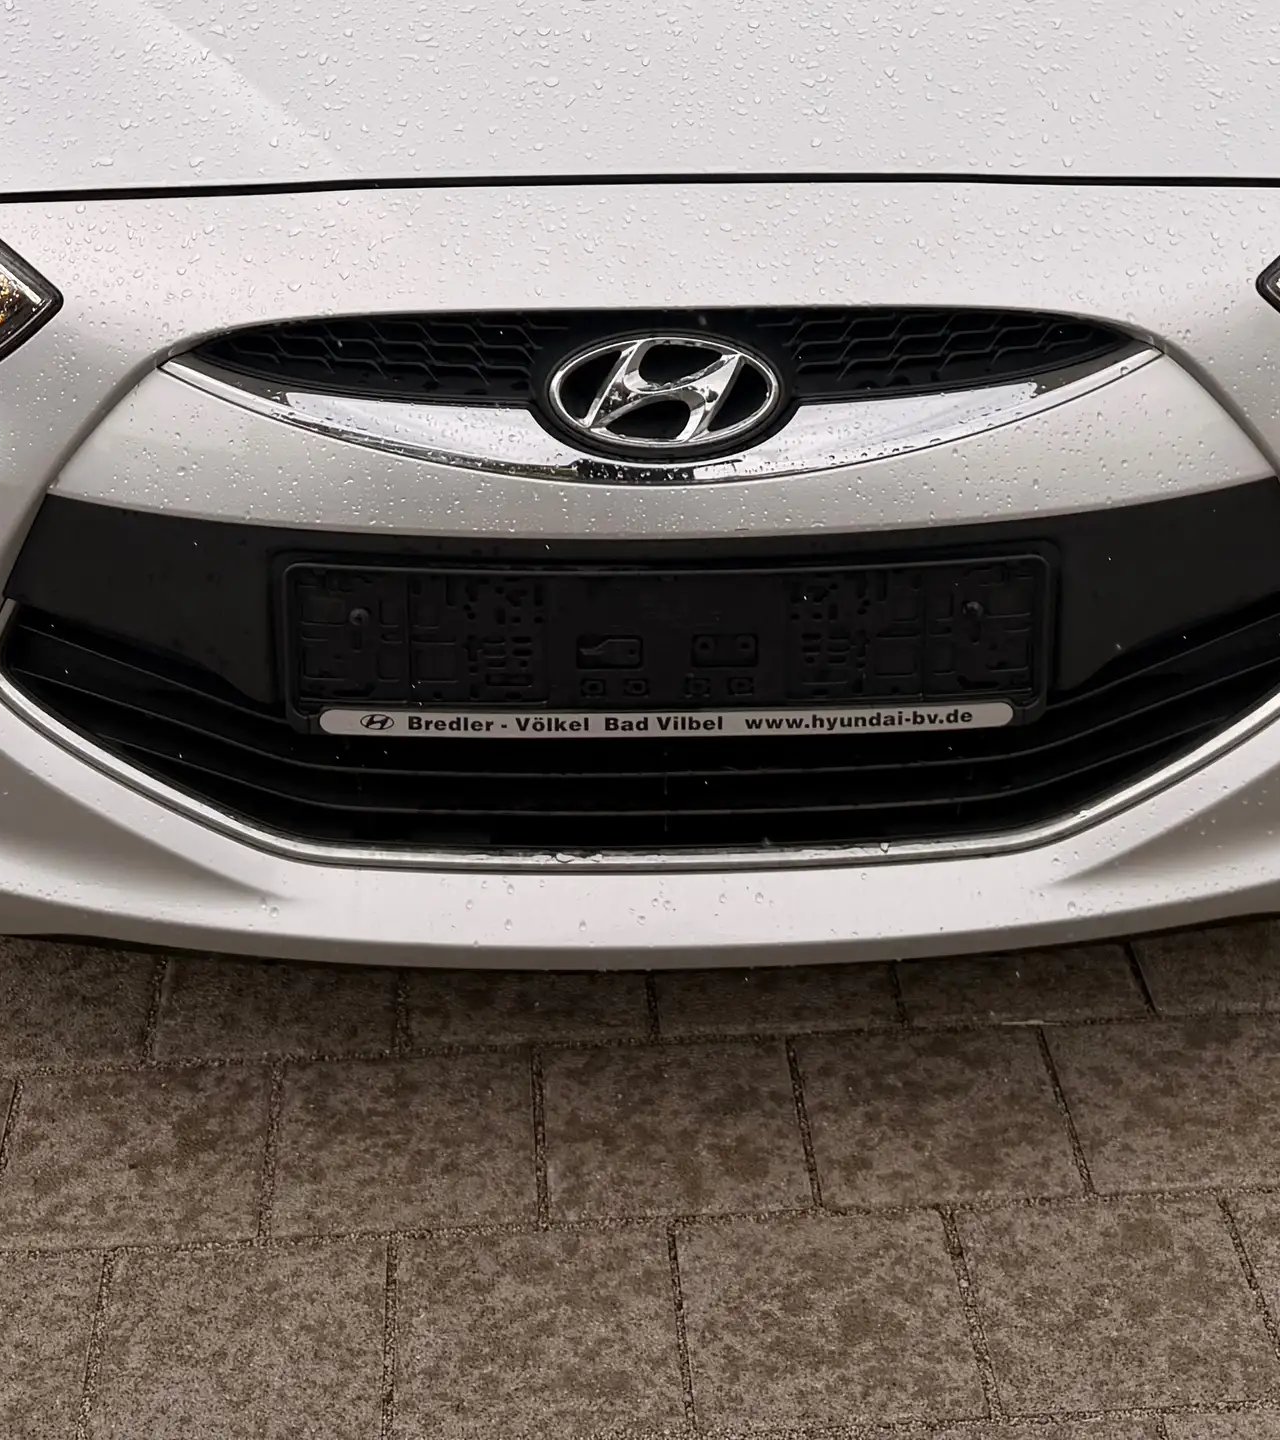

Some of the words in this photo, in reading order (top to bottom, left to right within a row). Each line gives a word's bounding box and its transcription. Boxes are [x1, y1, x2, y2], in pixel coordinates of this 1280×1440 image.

[407, 715, 494, 732] Bredler
[515, 716, 589, 732] Völkel
[604, 716, 649, 732] Bad
[656, 715, 724, 732] Vilbel
[745, 709, 973, 732] www.hyundai-bv.de
